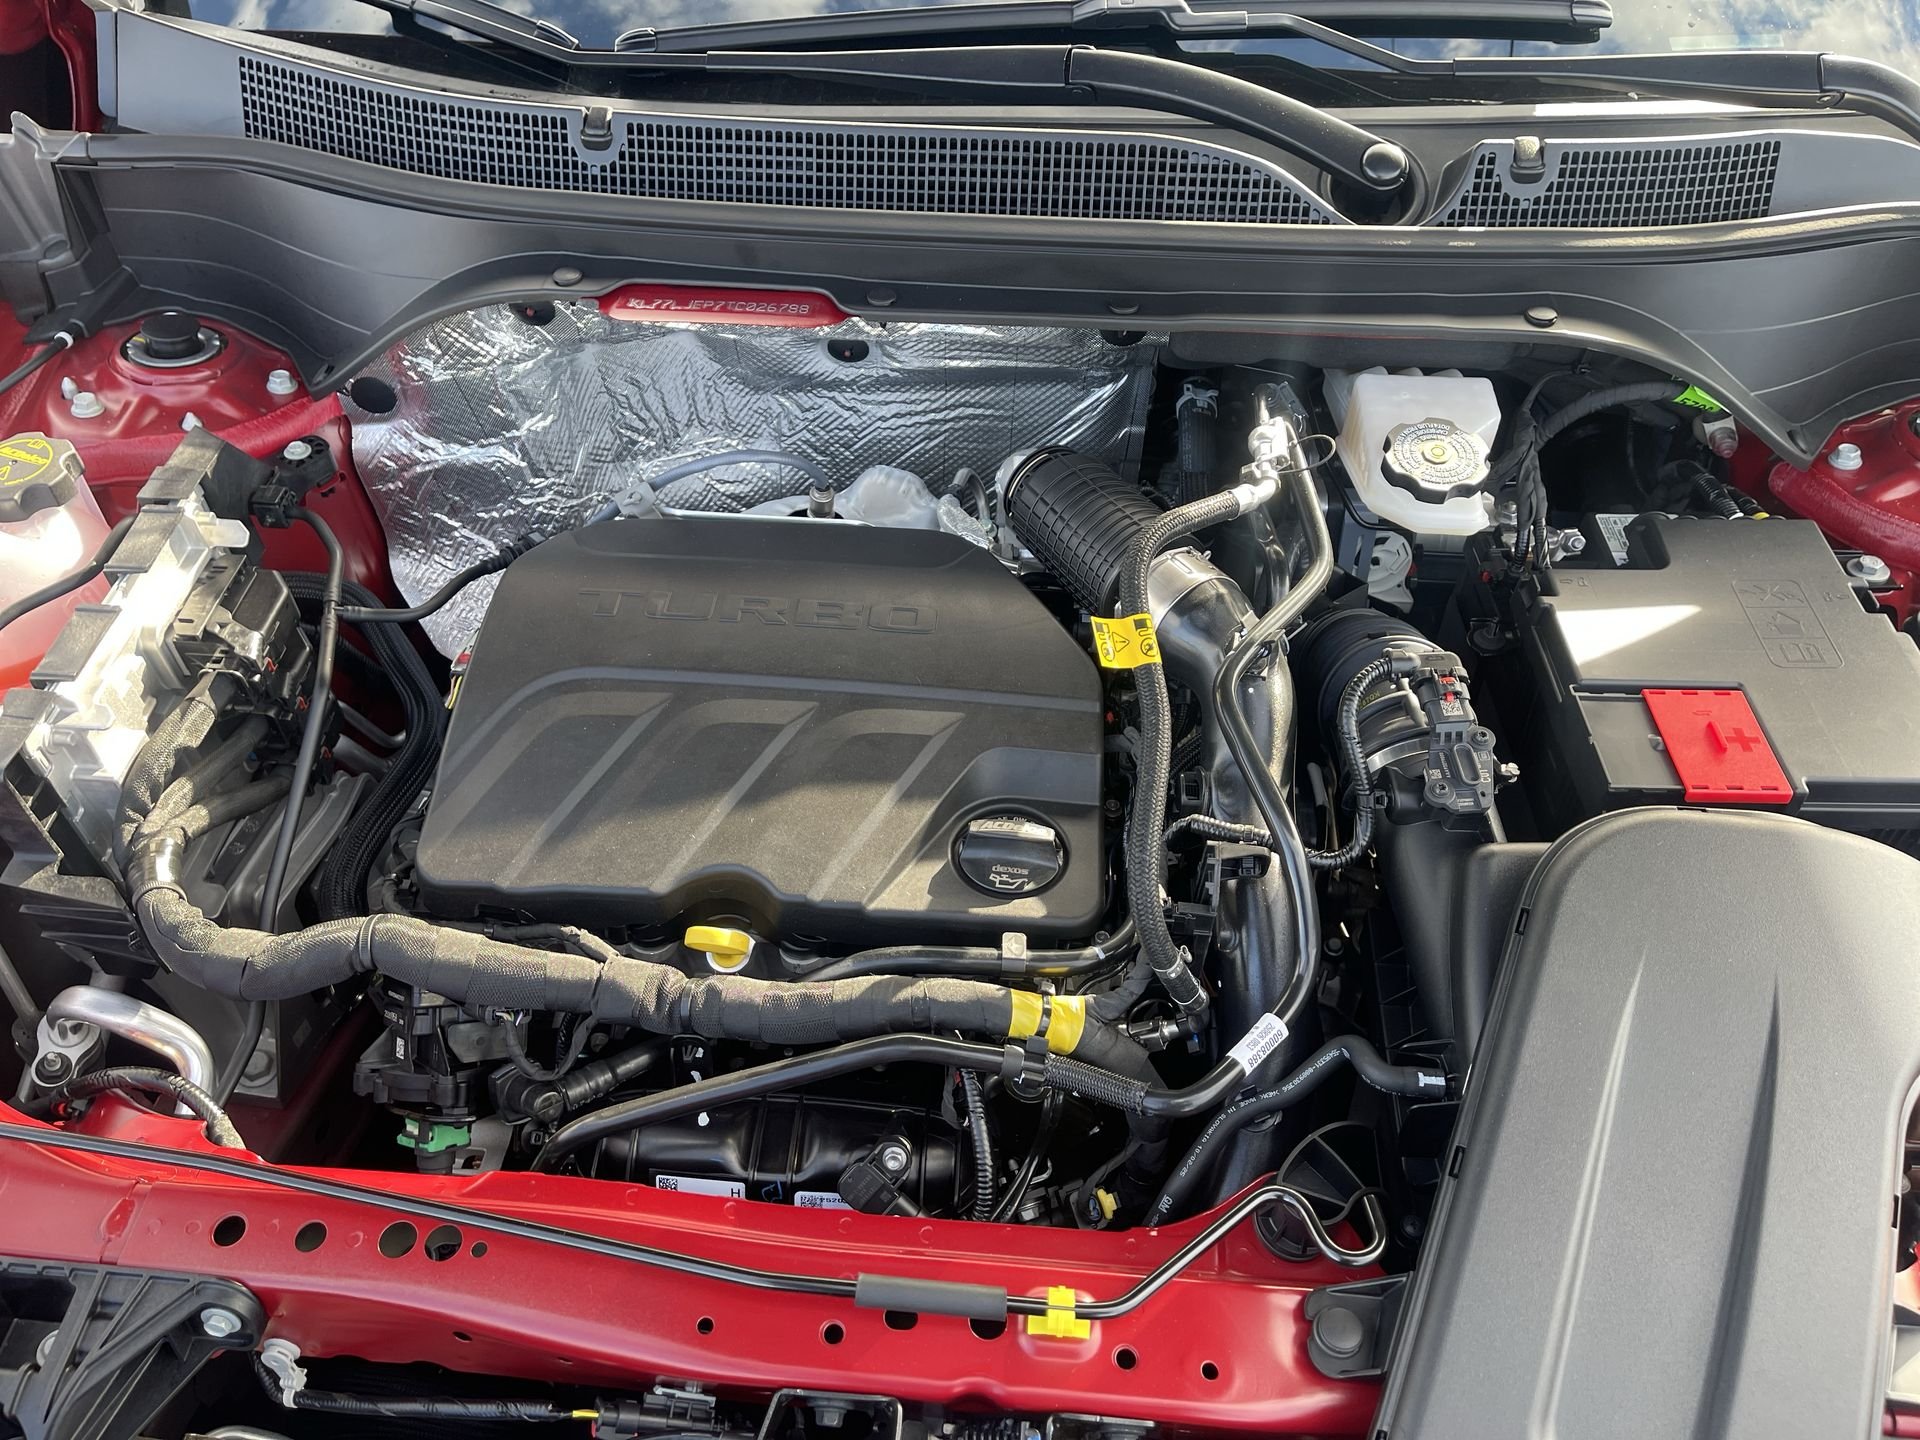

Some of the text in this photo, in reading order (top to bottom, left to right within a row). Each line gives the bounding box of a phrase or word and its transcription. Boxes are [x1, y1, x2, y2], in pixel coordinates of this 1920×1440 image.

[578, 588, 939, 635] TURBO
[992, 864, 1030, 875] dexos
[1239, 1097, 1257, 1108] MADE
[1227, 1105, 1237, 1115] IN
[1201, 1113, 1227, 1143] SLOVAKIA
[730, 1187, 741, 1198] H
